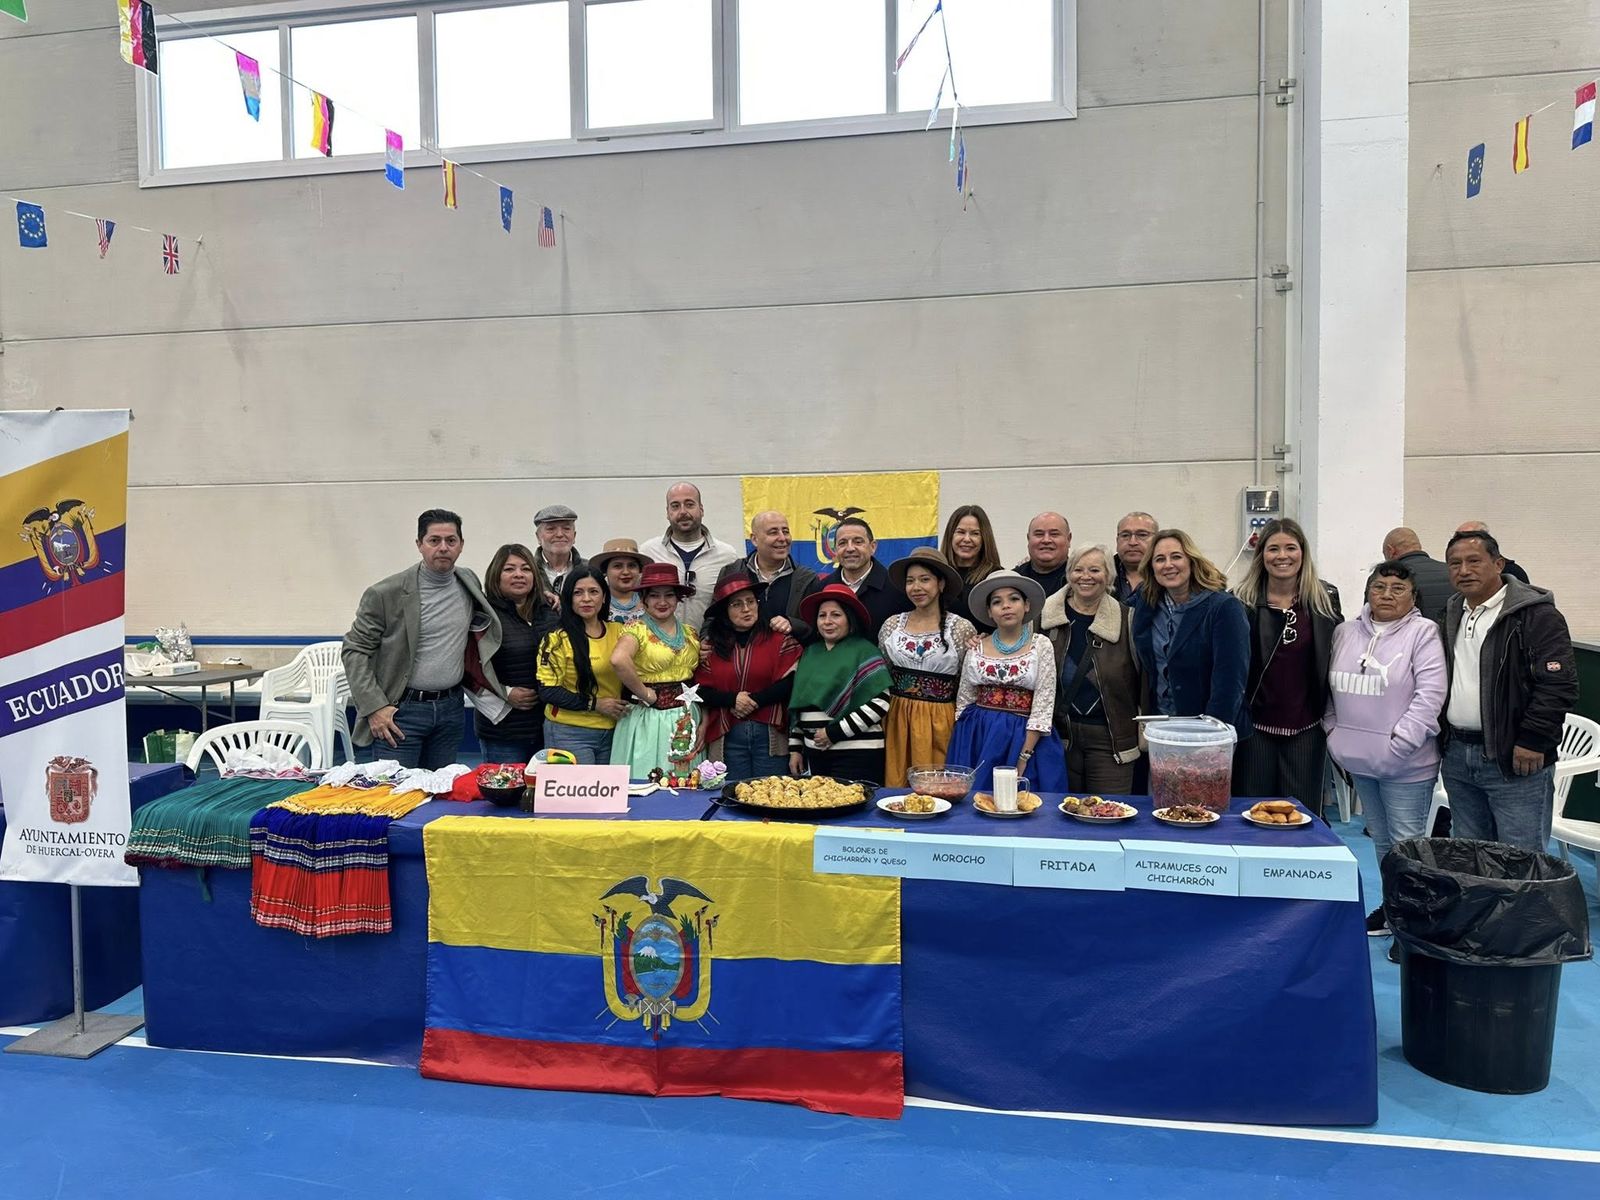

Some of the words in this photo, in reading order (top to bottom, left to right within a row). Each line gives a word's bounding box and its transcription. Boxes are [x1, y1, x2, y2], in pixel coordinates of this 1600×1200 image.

[5, 662, 124, 722] ECUADOR
[544, 780, 620, 798] Ecuador
[19, 828, 126, 846] AYUNTAMIENTO
[26, 844, 36, 855] DE
[38, 846, 115, 858] HUERCAL-OVERA
[842, 845, 876, 855] BOLONES
[878, 847, 888, 855] DE
[823, 854, 872, 864] CHICHARRÓN
[873, 856, 878, 864] Y
[880, 857, 907, 866] QUESO
[932, 853, 986, 865] MOROCHO
[1040, 859, 1096, 872] FRITADA
[1135, 860, 1201, 873] ALTRAMUCES
[1205, 864, 1228, 875] CON
[1263, 868, 1333, 880] EMPANADAS
[1147, 873, 1215, 887] CHICHARRÓN
